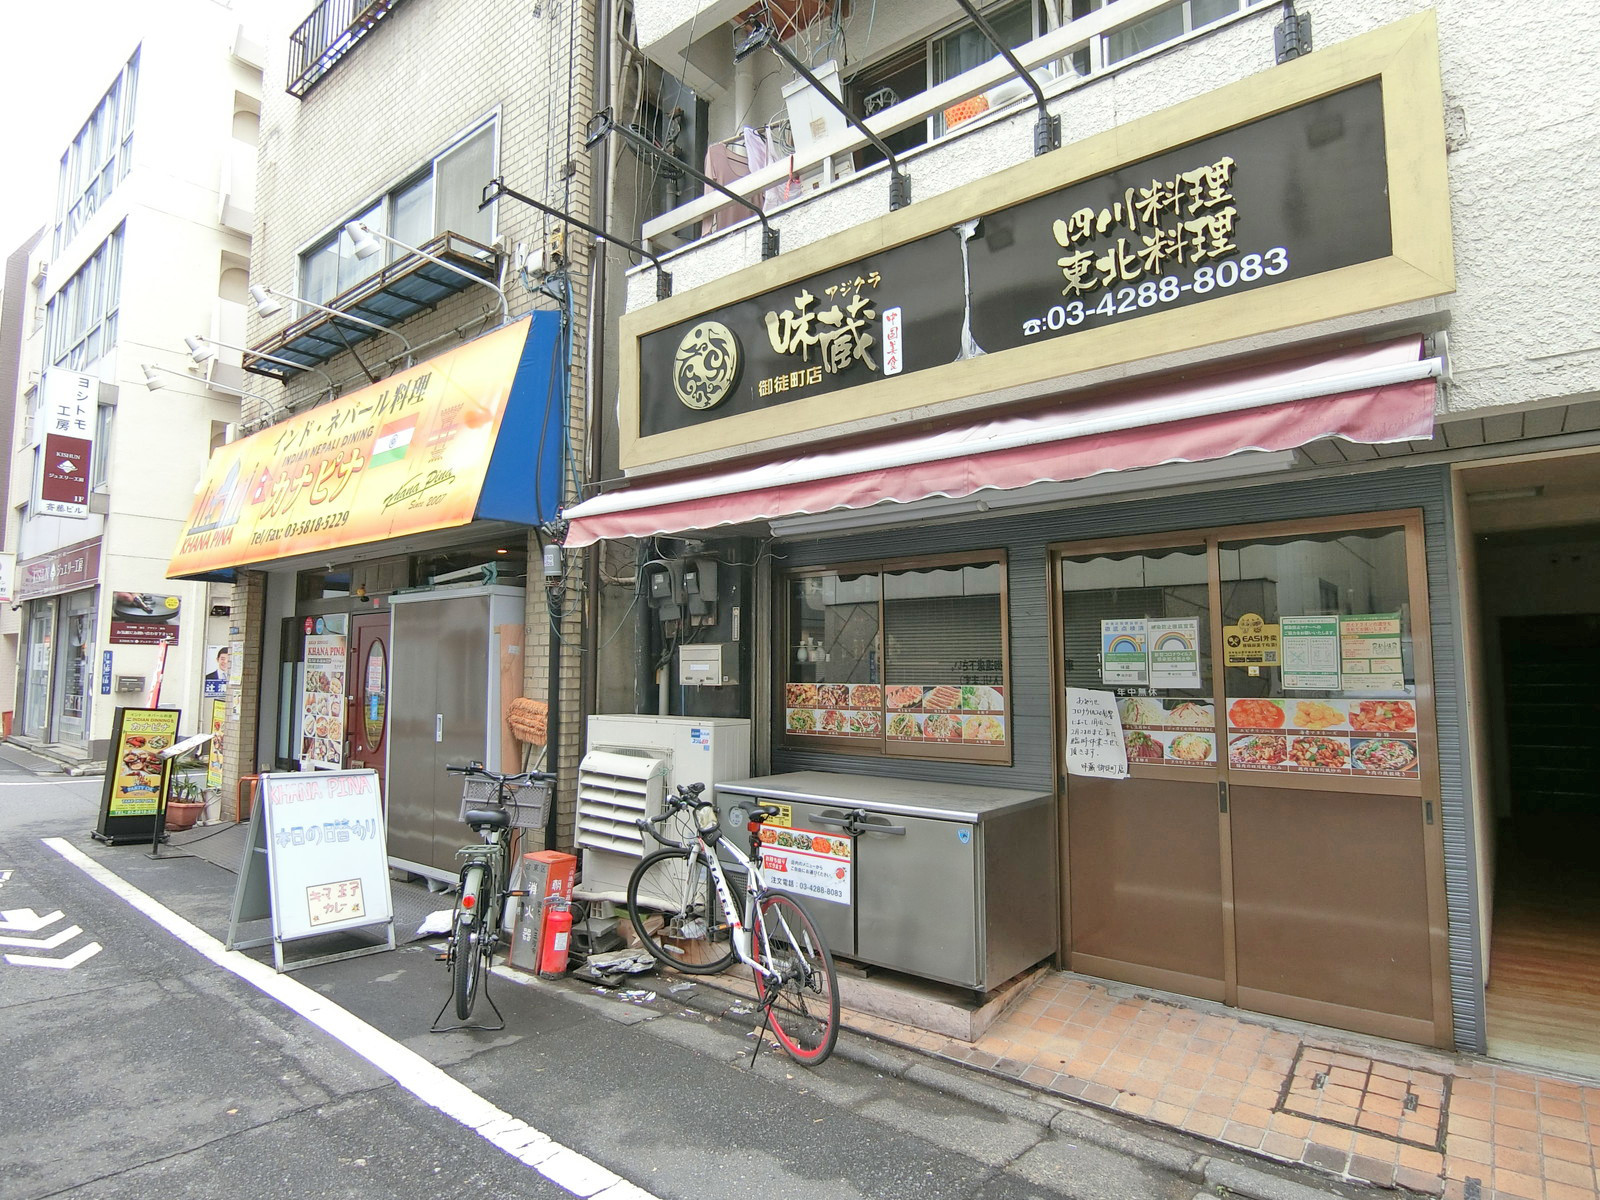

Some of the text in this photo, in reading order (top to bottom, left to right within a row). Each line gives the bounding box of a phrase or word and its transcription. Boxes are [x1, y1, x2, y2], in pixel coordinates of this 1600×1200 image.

[1053, 156, 1237, 248] 四川料理
[1057, 206, 1239, 297] 東北料理
[764, 289, 879, 375] 味蔵
[758, 365, 823, 398] 御徒町店
[55, 405, 71, 431] 工房
[74, 377, 90, 431] ヨシトモ
[273, 371, 433, 457] インド・ネパール料理
[282, 425, 375, 467] INDIAN NEPALI DINING
[260, 447, 366, 521] カナピナ
[179, 529, 234, 555] KHANA PINA
[250, 510, 350, 546] Tel/Fax: 03-5818-5229
[308, 646, 346, 656] KHANA PINA
[1116, 687, 1158, 697] 年中無休
[270, 775, 373, 805] KHANA PINA
[275, 818, 377, 848] 本日の日替わり
[799, 881, 843, 898] 03-4288-8083
[522, 881, 538, 942] 消火器
